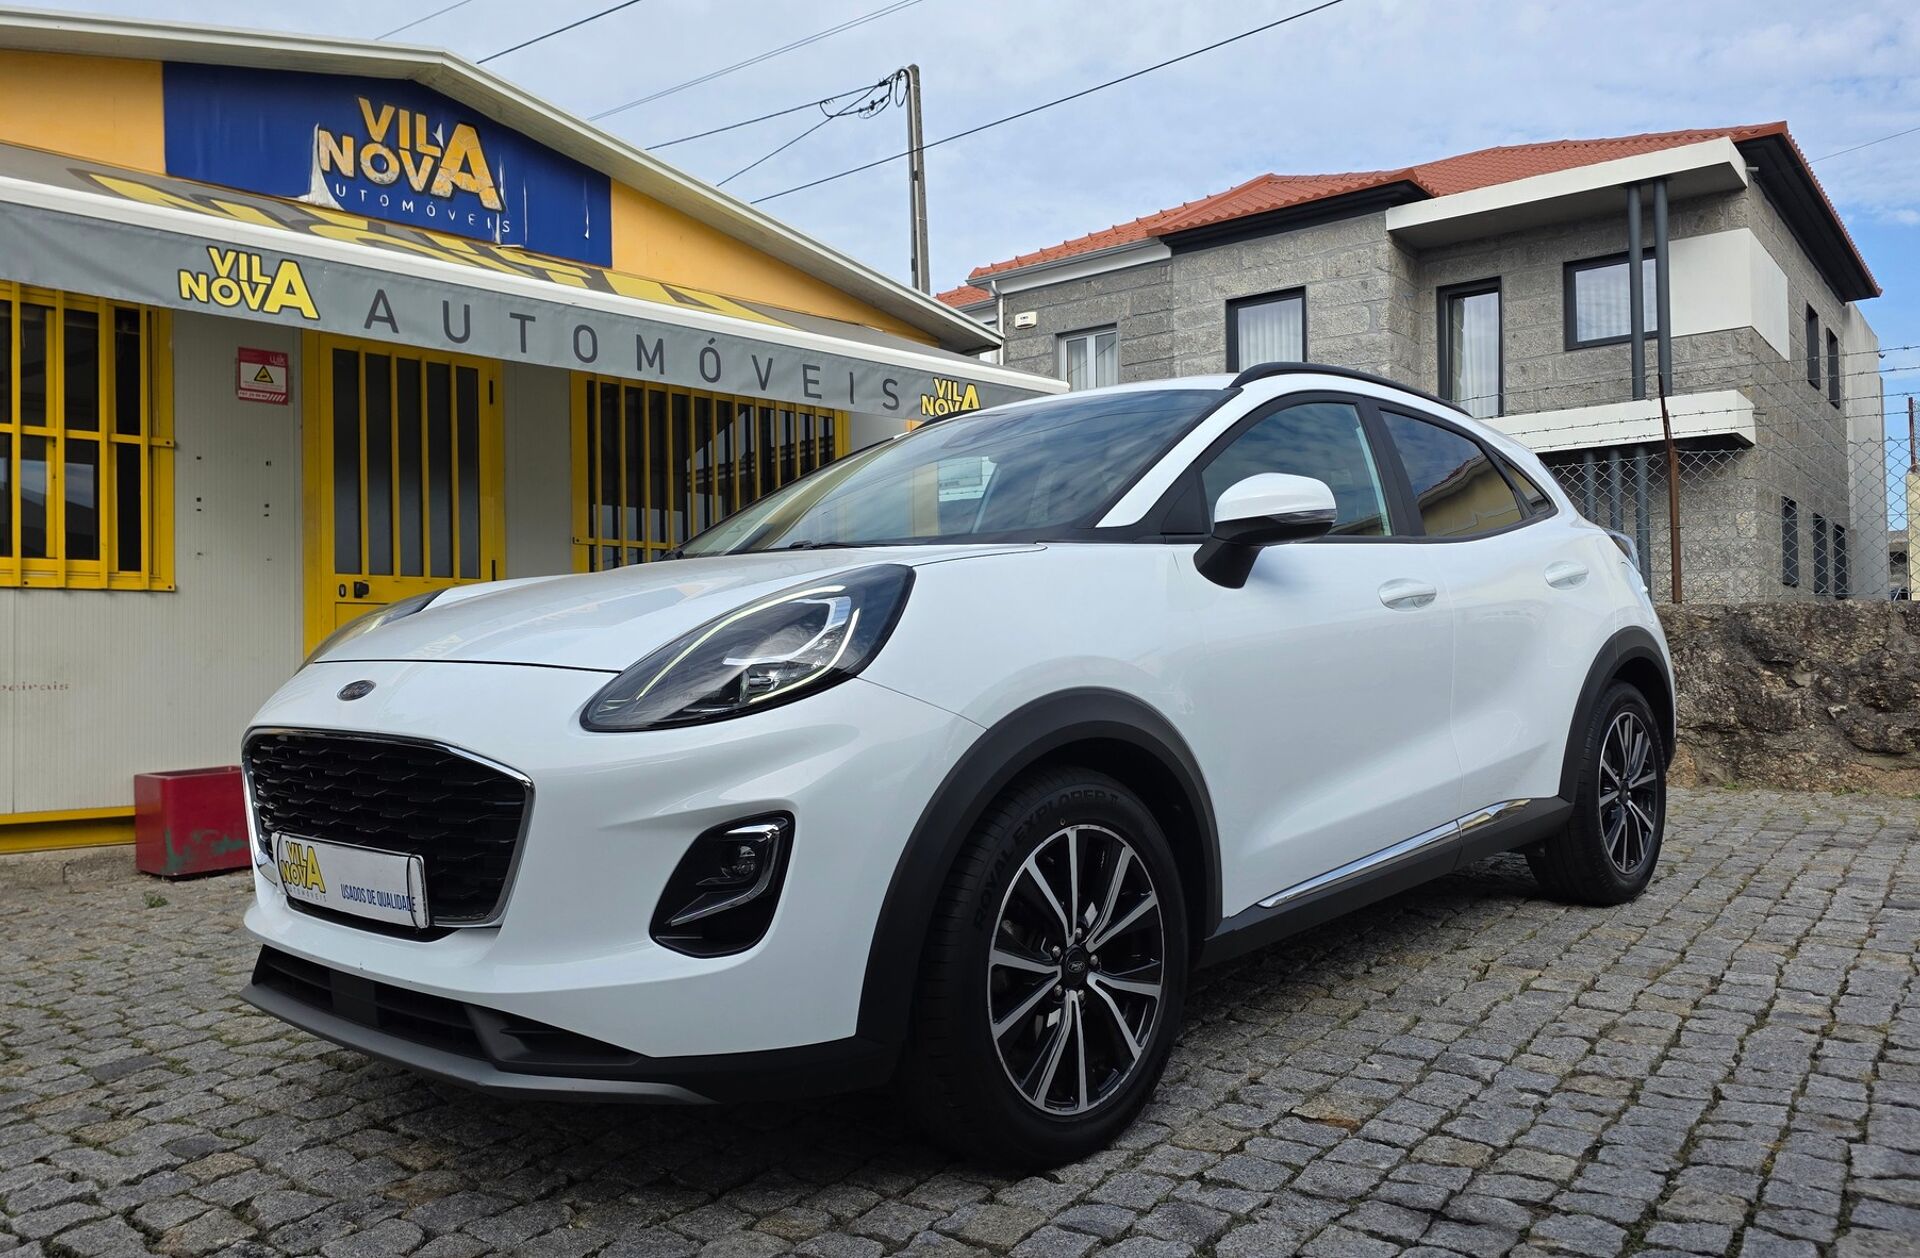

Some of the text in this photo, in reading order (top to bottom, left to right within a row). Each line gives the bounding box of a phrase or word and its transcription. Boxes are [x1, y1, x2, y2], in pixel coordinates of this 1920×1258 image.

[358, 97, 502, 211] VILA
[178, 259, 320, 320] NOVA
[207, 246, 320, 320] VILA
[363, 288, 900, 411] AUTOMÓVEIS
[933, 377, 981, 411] VILA
[286, 841, 326, 893] VILA
[340, 883, 416, 913] USADOS DE QUALIDADE
